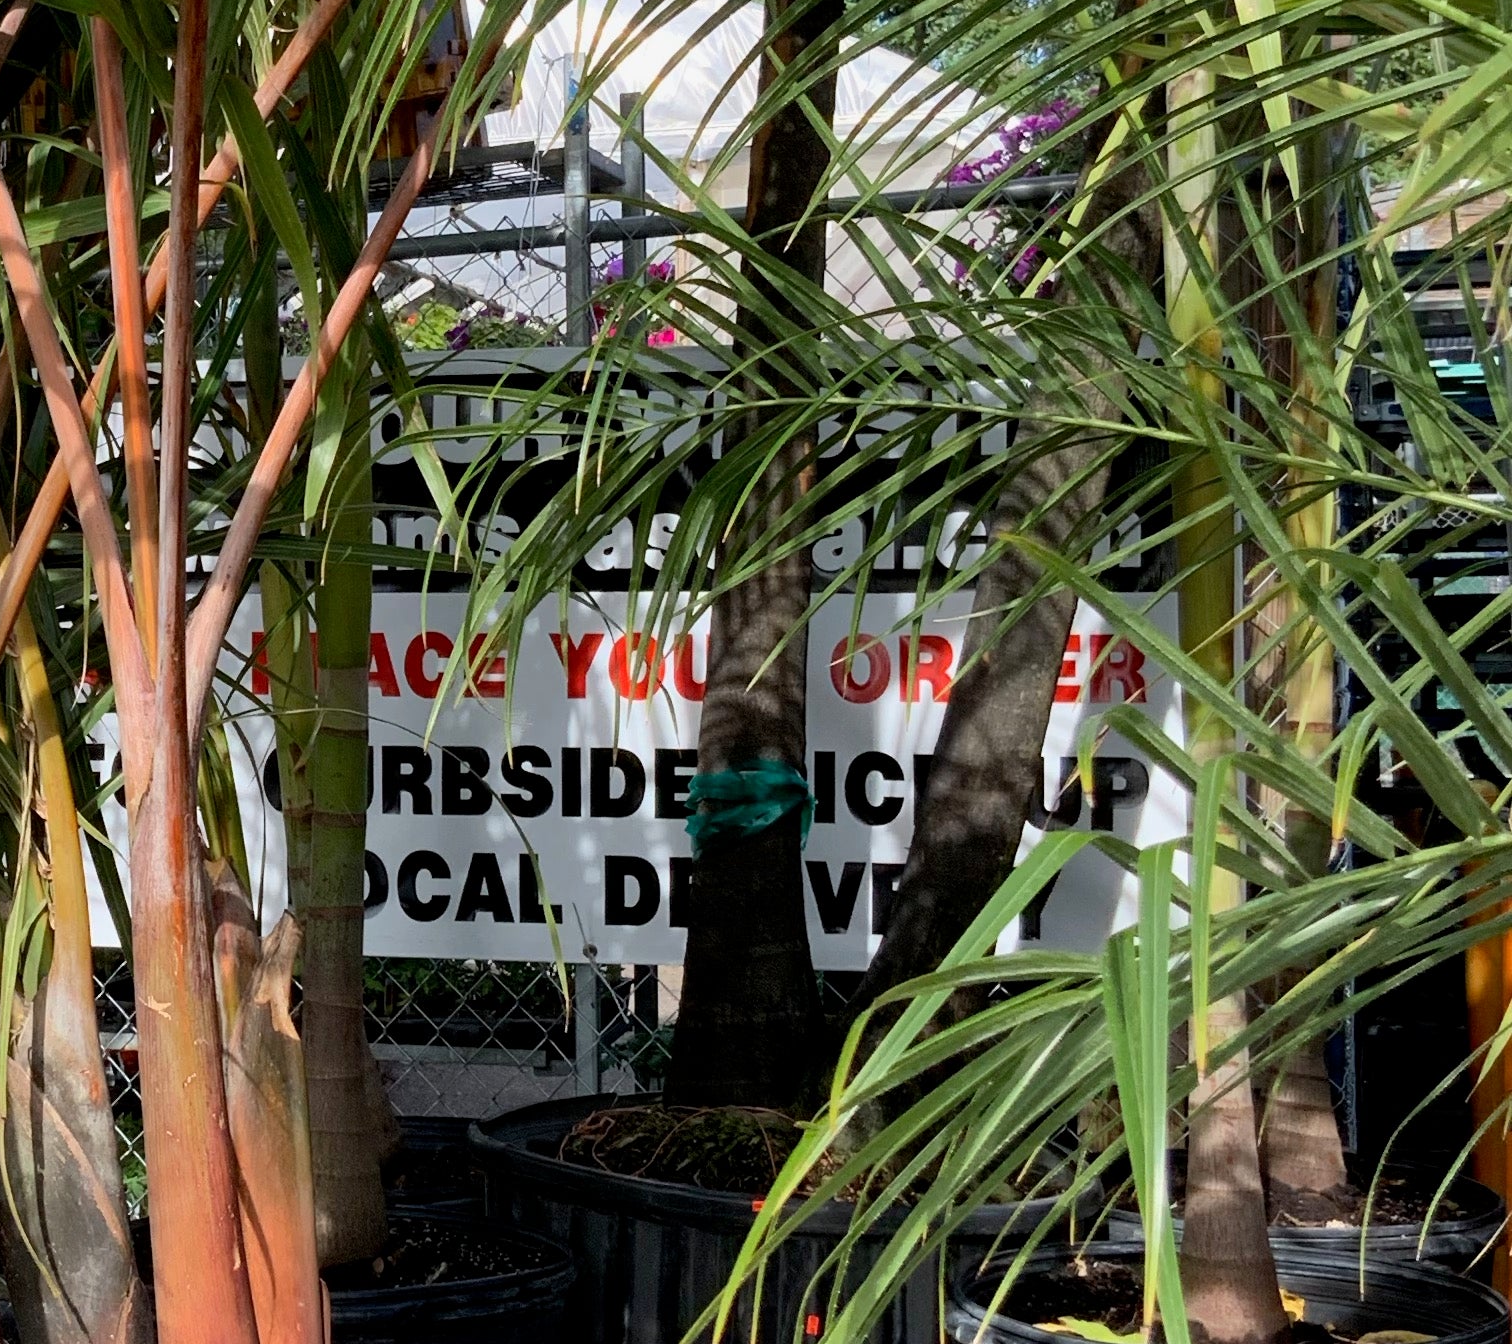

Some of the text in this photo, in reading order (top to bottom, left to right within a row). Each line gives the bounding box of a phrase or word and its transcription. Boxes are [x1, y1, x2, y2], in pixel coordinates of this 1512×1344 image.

[550, 633, 710, 701] YOU
[830, 633, 1147, 704] ORER
[263, 744, 698, 820] RBSIDE
[1028, 756, 1150, 832] UP
